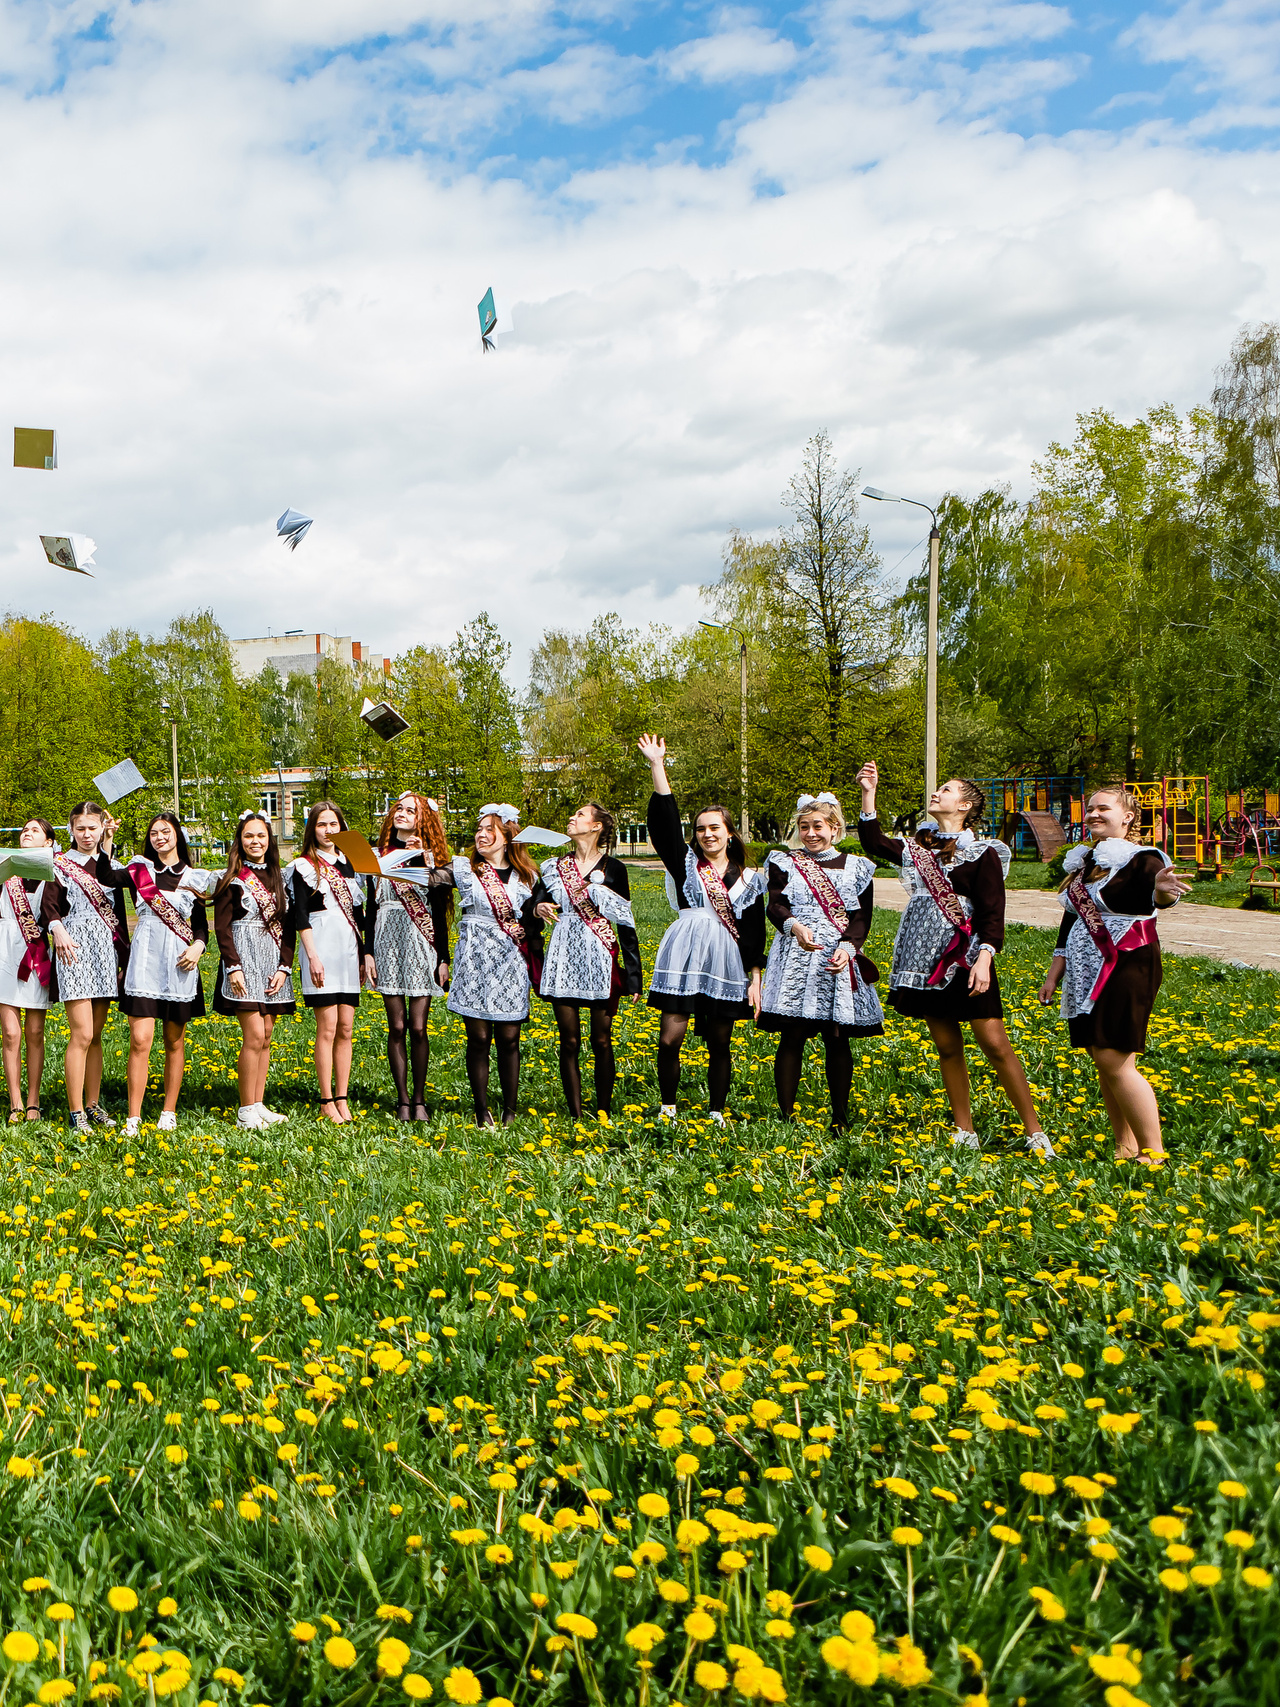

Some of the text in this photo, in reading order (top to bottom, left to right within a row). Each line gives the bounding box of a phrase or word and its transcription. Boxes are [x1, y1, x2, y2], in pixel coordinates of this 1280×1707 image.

[20, 915, 41, 942] 2022
[99, 903, 120, 931] 2022
[593, 918, 616, 947] 2022
